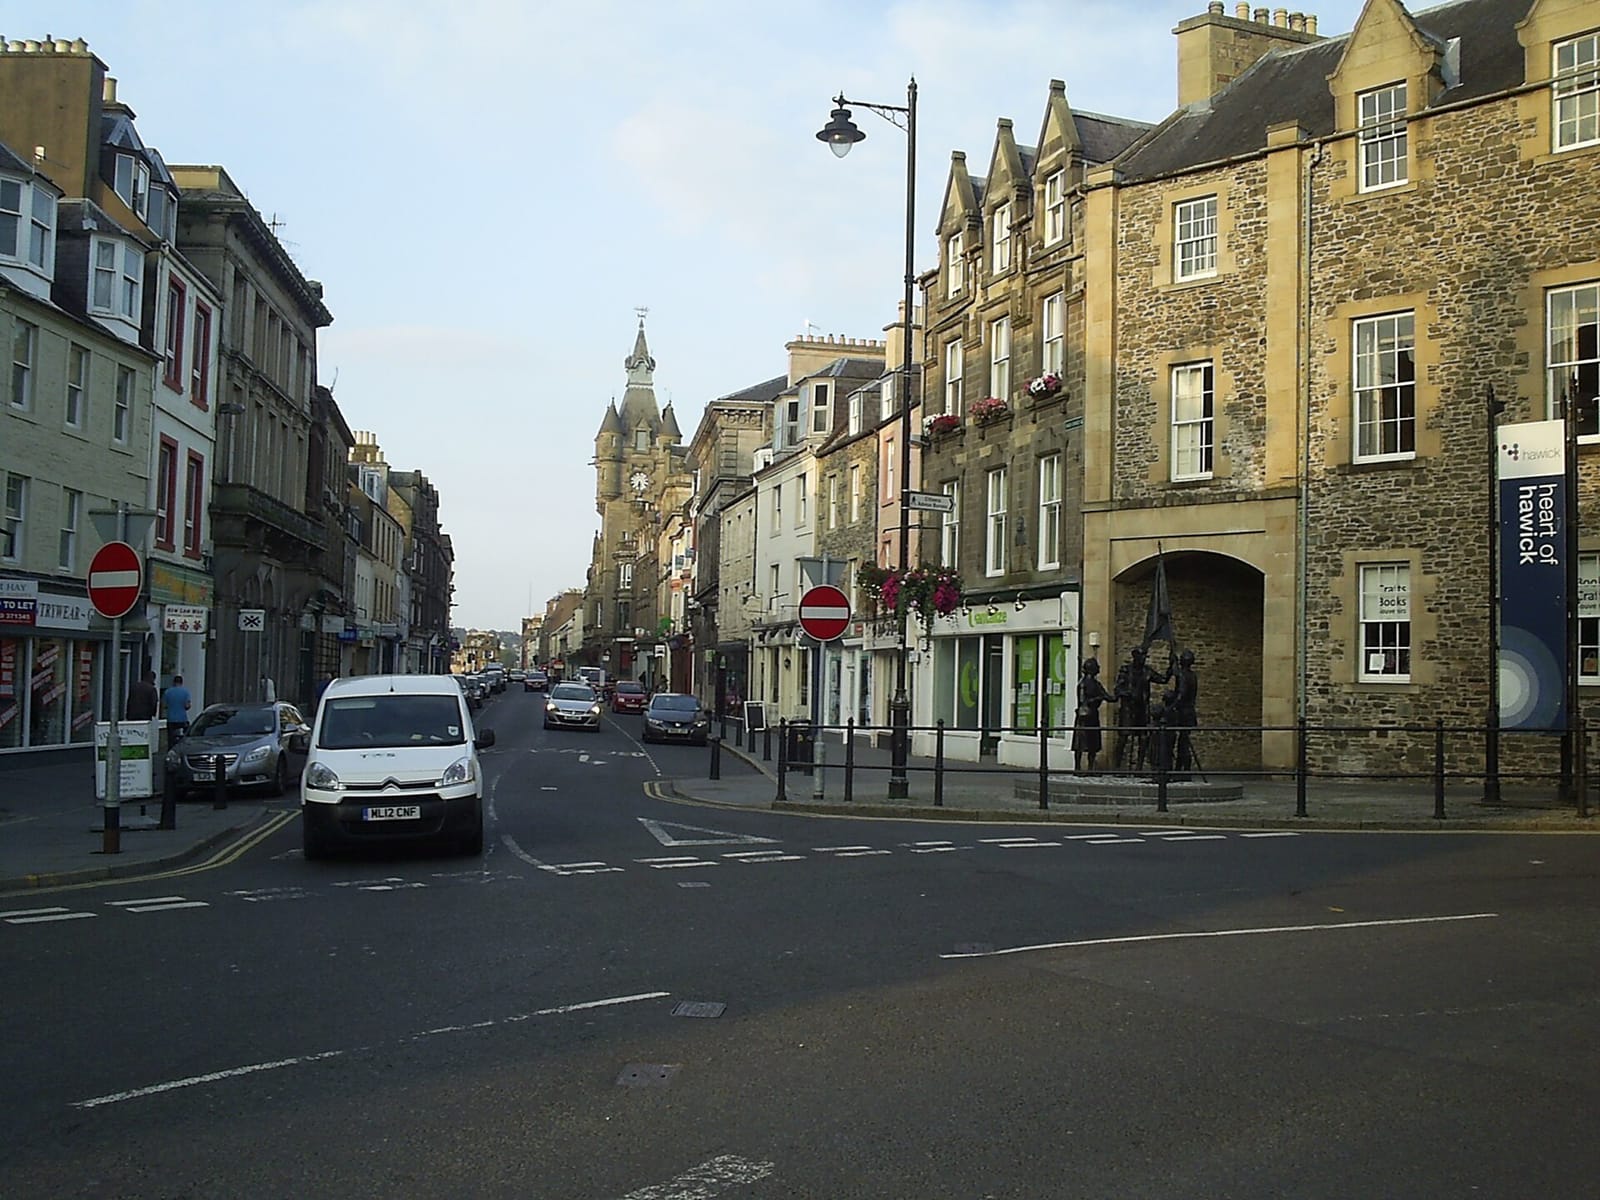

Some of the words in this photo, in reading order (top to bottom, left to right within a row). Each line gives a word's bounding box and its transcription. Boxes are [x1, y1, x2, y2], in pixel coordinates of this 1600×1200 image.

[1522, 447, 1561, 461] hawick
[1539, 483, 1558, 538] heart
[1519, 485, 1538, 565] hawick
[1539, 544, 1559, 565] of
[3, 601, 15, 609] TO
[17, 602, 35, 610] LET
[396, 808, 417, 817] CNF
